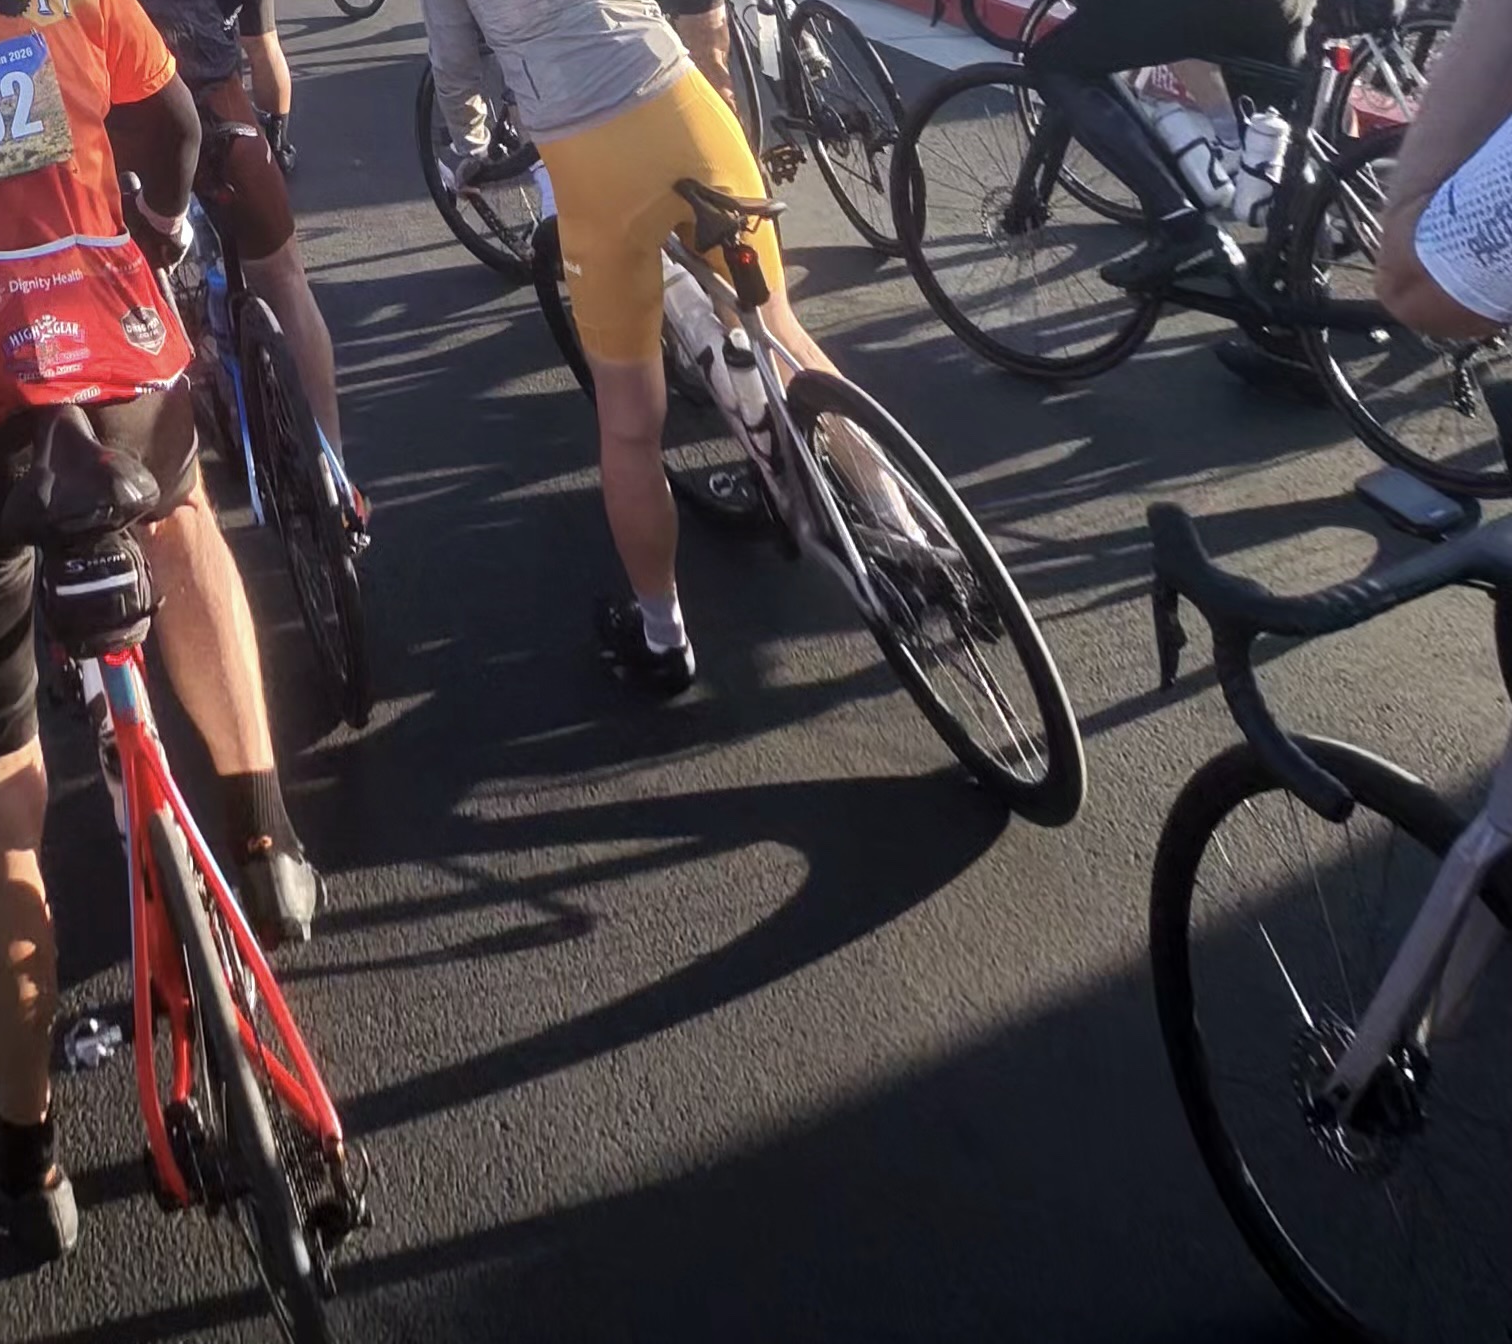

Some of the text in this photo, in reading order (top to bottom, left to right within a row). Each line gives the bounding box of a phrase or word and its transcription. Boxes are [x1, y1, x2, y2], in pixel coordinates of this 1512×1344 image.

[8, 47, 34, 63] 2026
[9, 269, 85, 294] Dignity Health
[9, 321, 80, 347] HIGH GEAR
